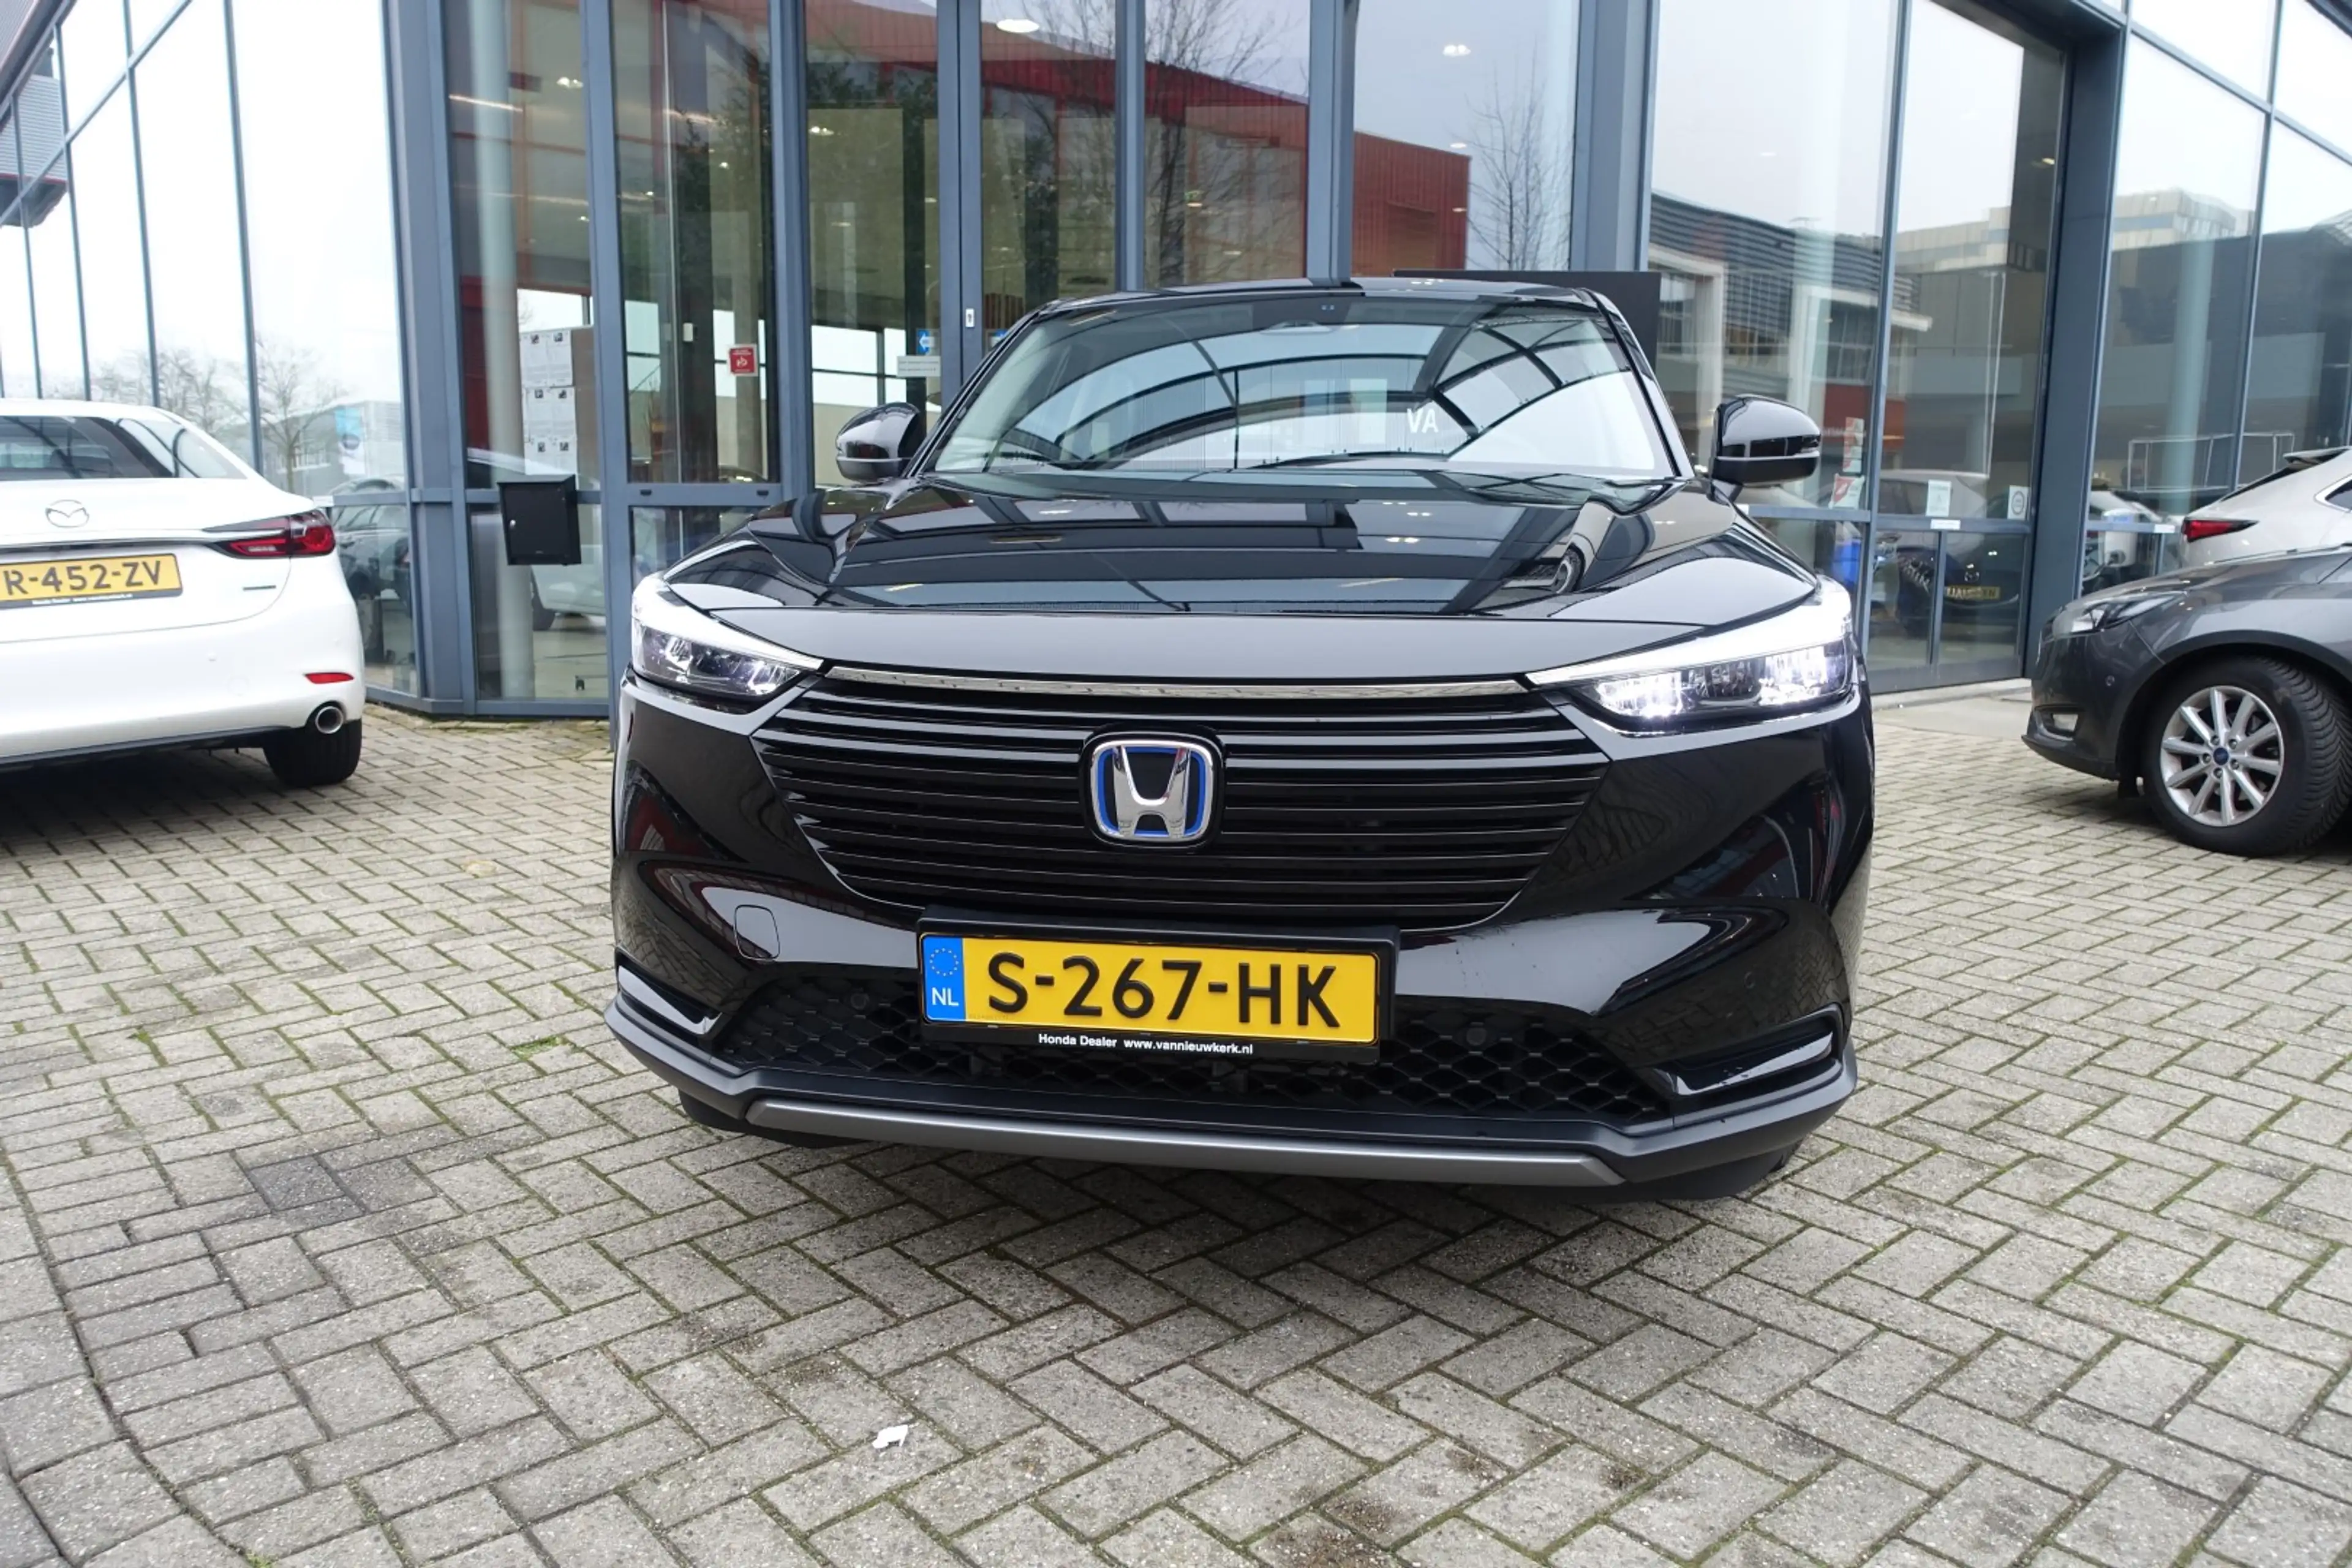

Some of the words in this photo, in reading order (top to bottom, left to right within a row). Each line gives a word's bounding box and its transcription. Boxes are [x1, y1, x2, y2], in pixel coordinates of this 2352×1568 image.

[3, 560, 161, 595] R-452-ZV
[931, 987, 959, 1006] NL
[987, 951, 1340, 1028] S-267-HK
[1038, 1033, 1076, 1046] Honda
[1080, 1035, 1117, 1048] Dealer
[1123, 1038, 1253, 1055] www.vannieuwkerk.nl
